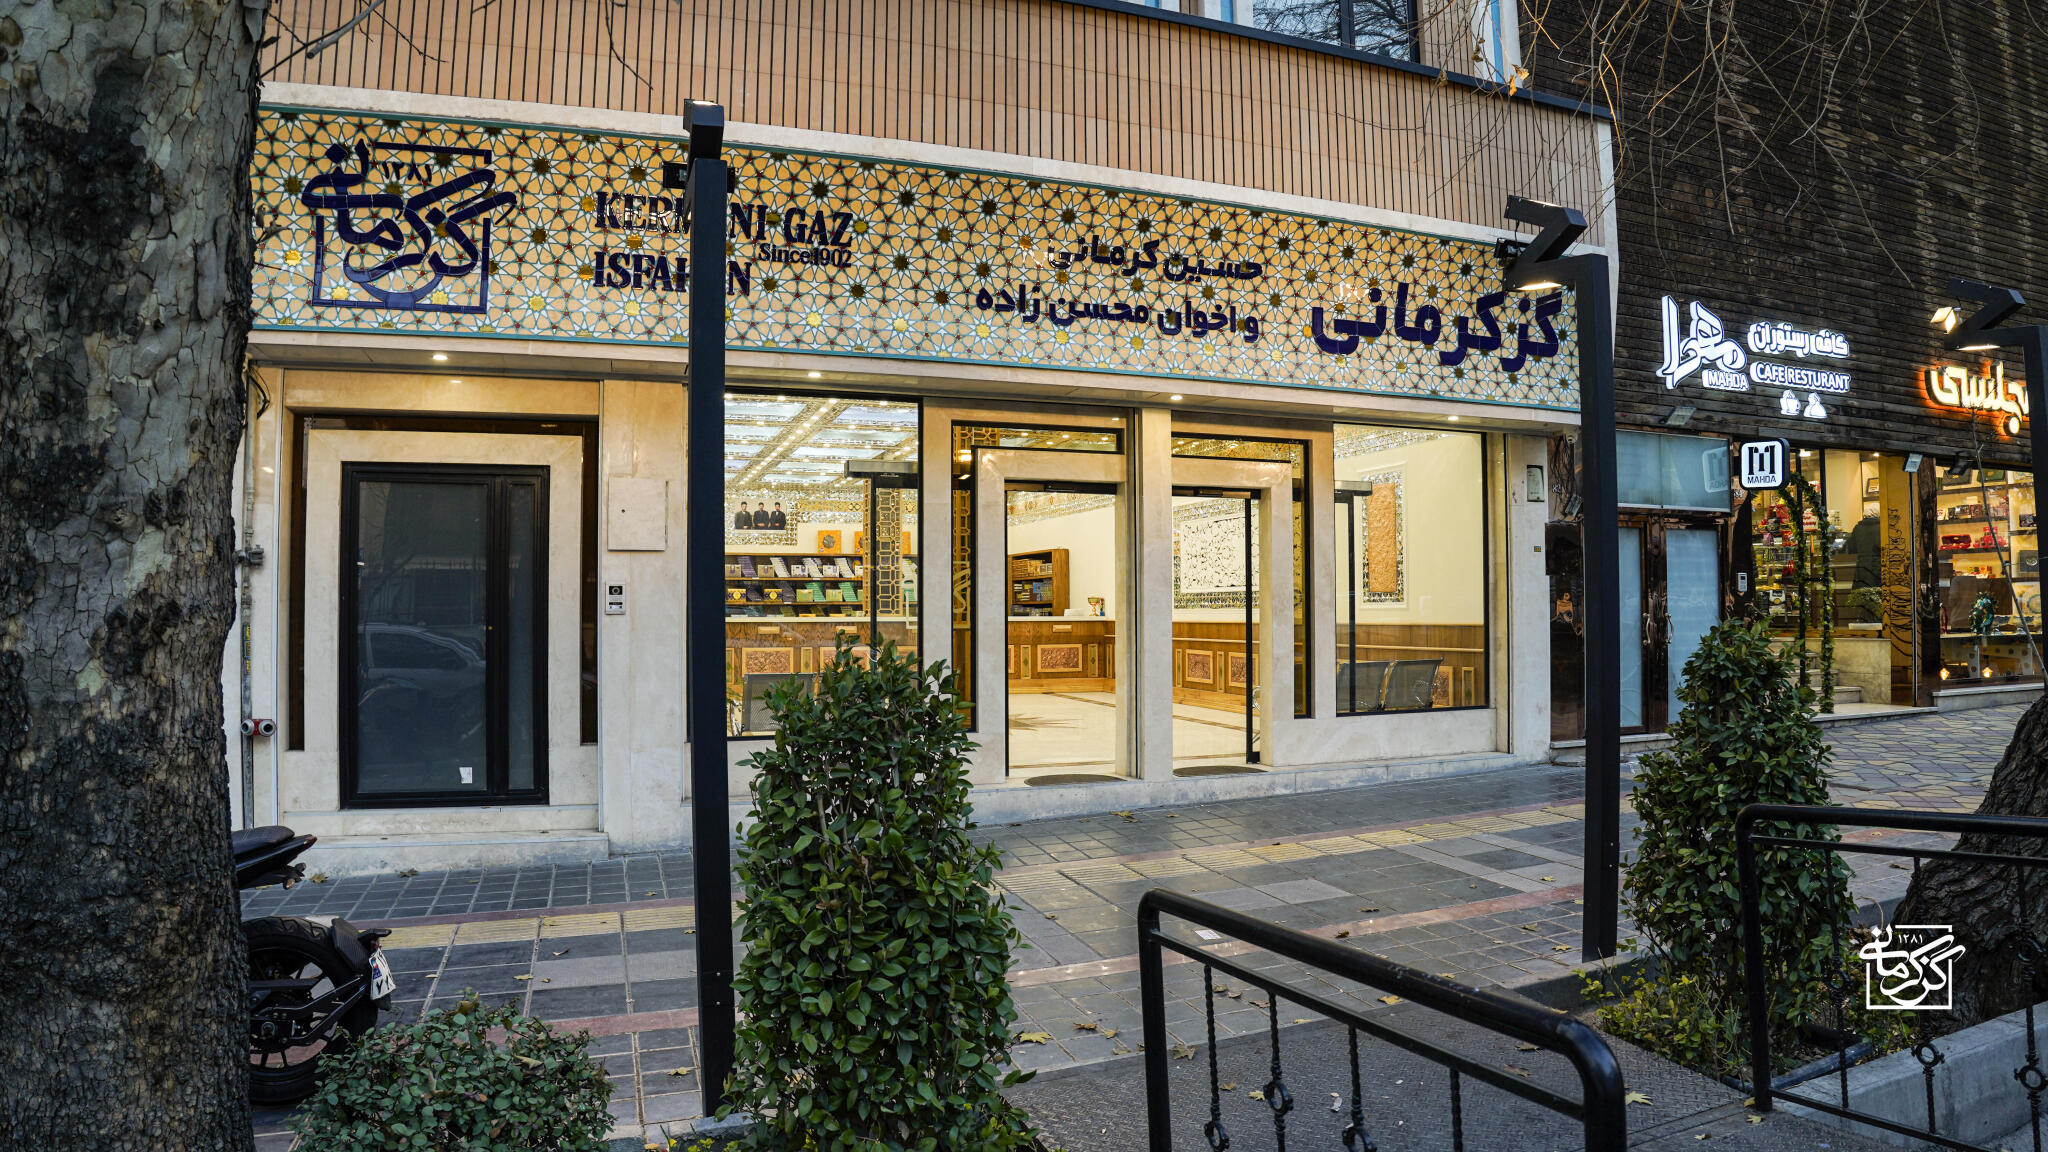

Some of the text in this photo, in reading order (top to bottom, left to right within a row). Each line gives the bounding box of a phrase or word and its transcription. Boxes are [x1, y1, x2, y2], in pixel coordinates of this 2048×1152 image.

[783, 206, 853, 247] GAZ
[1048, 234, 1263, 282] حسین کرمانی
[975, 283, 1259, 342] و اخوان محسن زاده
[1312, 282, 1563, 372] گز کرمانی
[1750, 321, 1850, 358] کافه رستوران
[1704, 369, 1750, 391] MAHDA
[1753, 361, 1851, 393] CAFE RESTURANT
[1747, 475, 1777, 485] MAHDA
